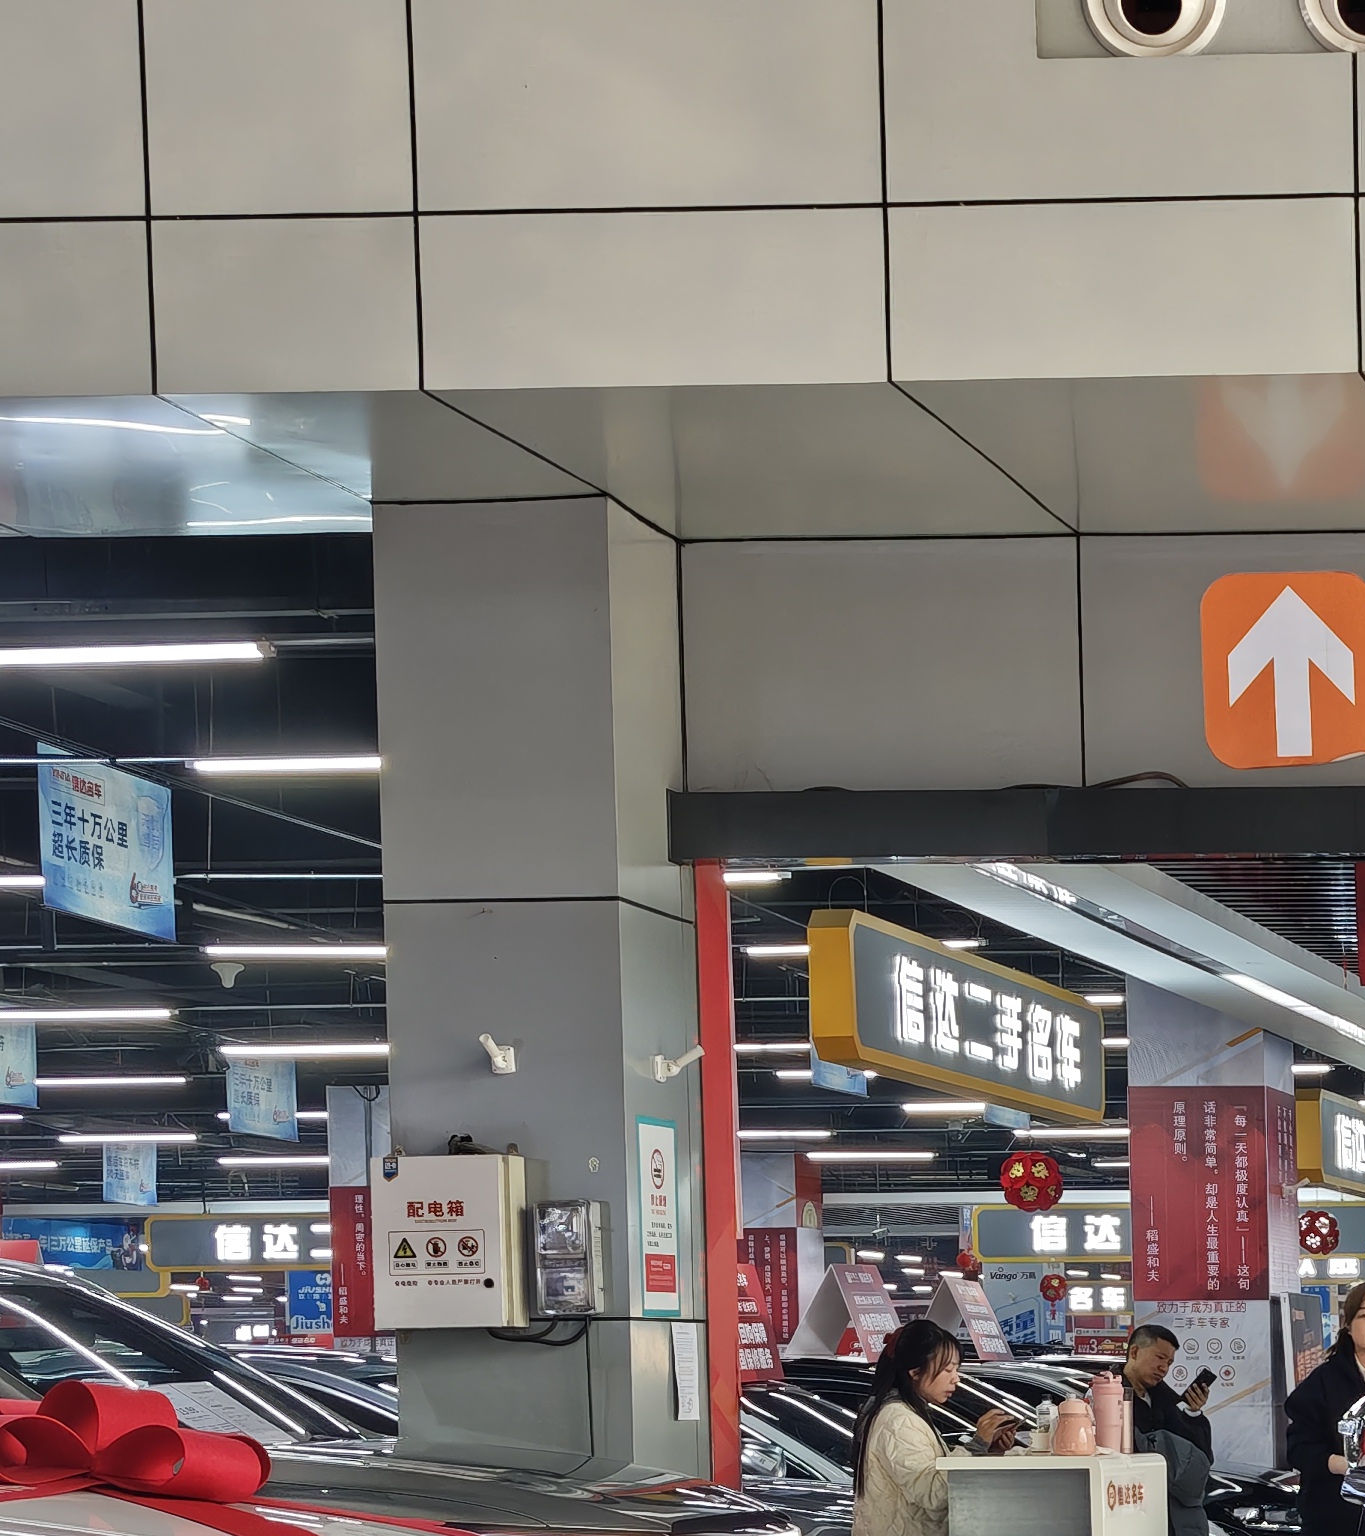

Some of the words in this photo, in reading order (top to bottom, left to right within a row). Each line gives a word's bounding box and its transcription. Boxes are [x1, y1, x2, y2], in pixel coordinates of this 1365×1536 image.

[51, 799, 129, 849] 三年十万公里
[51, 830, 105, 870] 超长质保
[892, 953, 1084, 1092] 信达二手名车
[1173, 1101, 1188, 1163] 原理原则。
[407, 1200, 464, 1218] 配电箱
[1030, 1214, 1122, 1254] 信达
[990, 1269, 1018, 1282] Vango
[1156, 1301, 1247, 1314] 致力于成为真正的
[1173, 1317, 1231, 1330] 二手车专家
